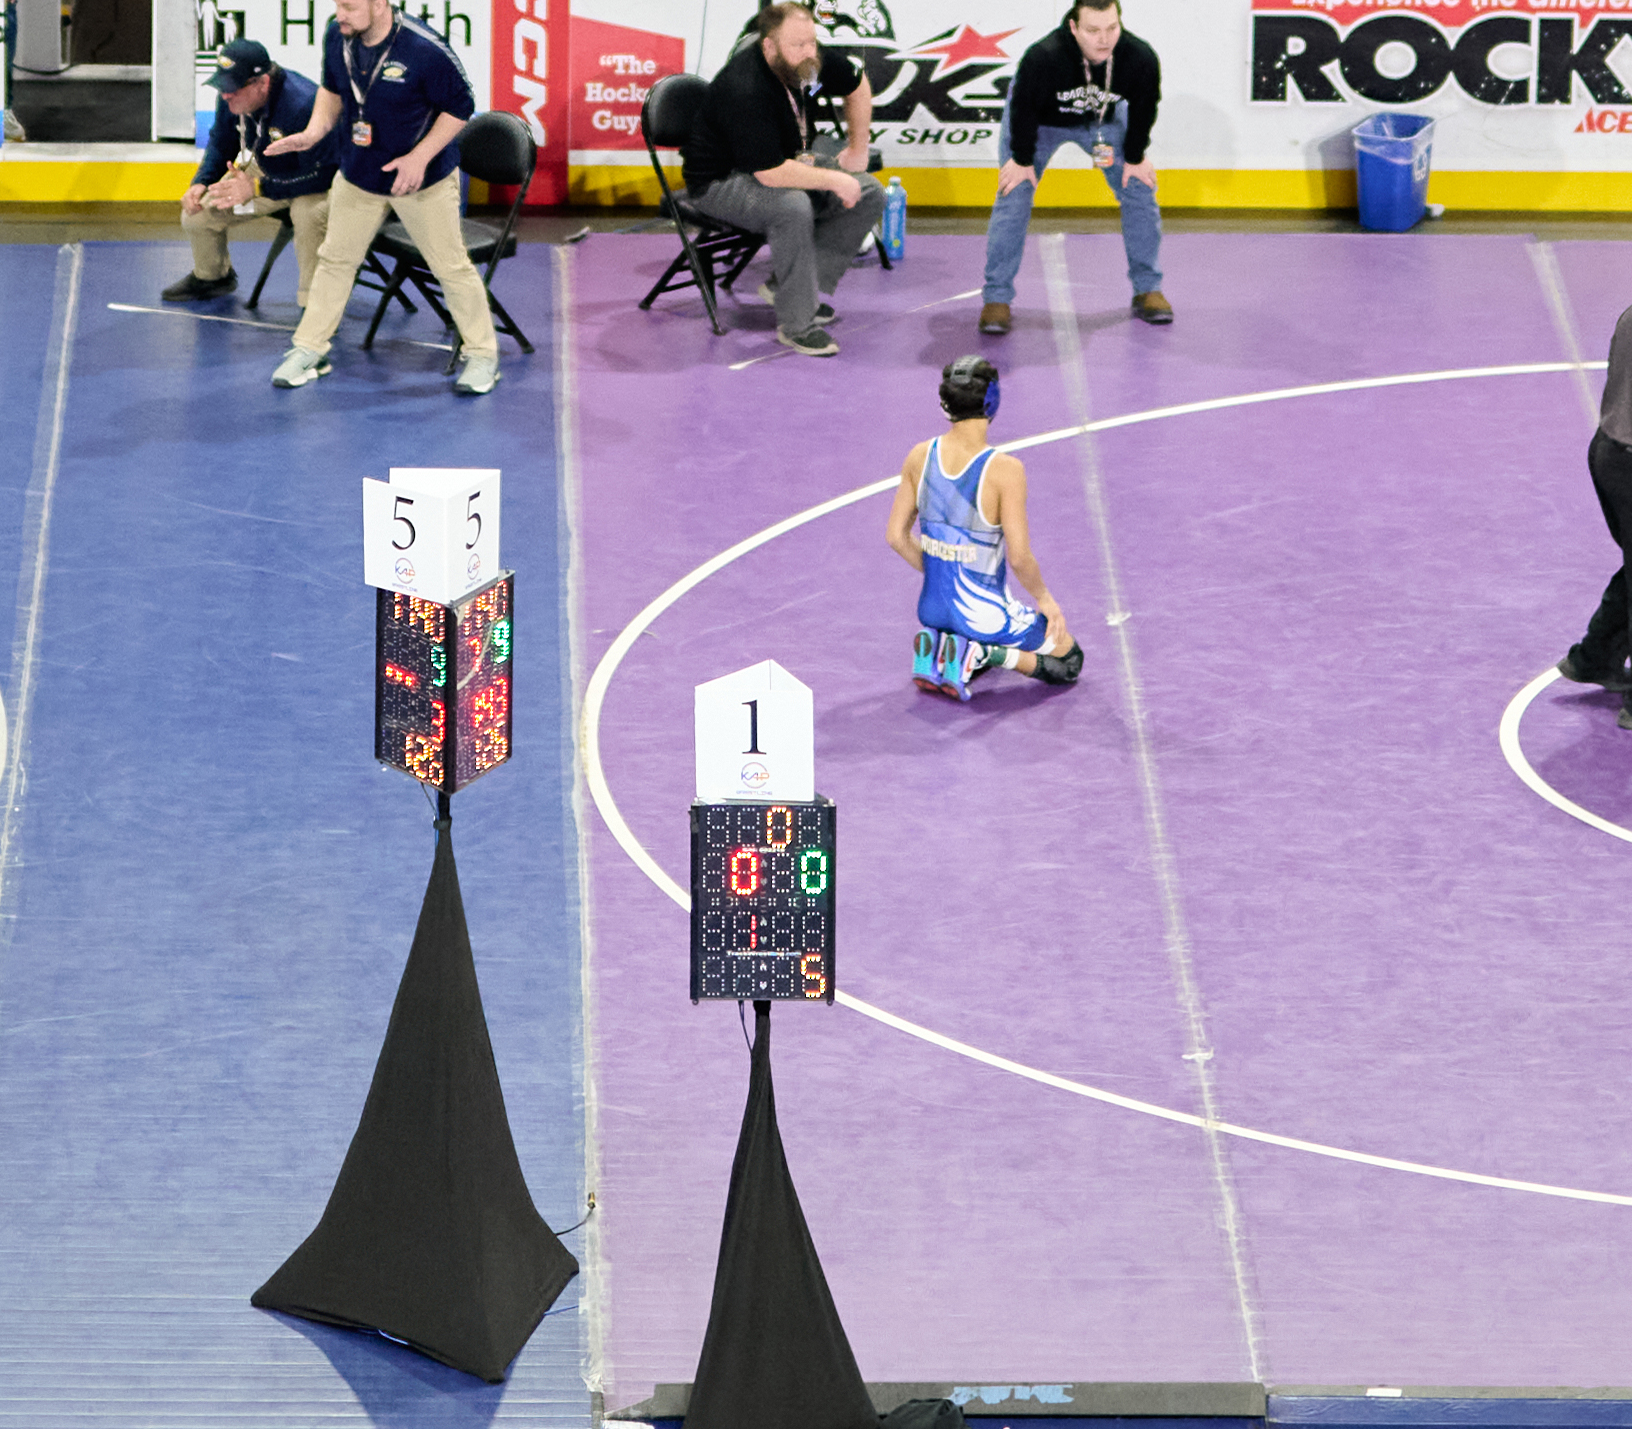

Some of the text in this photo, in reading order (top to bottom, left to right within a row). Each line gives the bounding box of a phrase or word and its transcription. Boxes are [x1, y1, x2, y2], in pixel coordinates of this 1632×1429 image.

[895, 128, 993, 146] SHOP
[391, 491, 482, 551] 5 5
[741, 699, 768, 756] 1
[765, 806, 792, 849] 0
[729, 851, 827, 895] 0 0
[748, 913, 759, 949] 1
